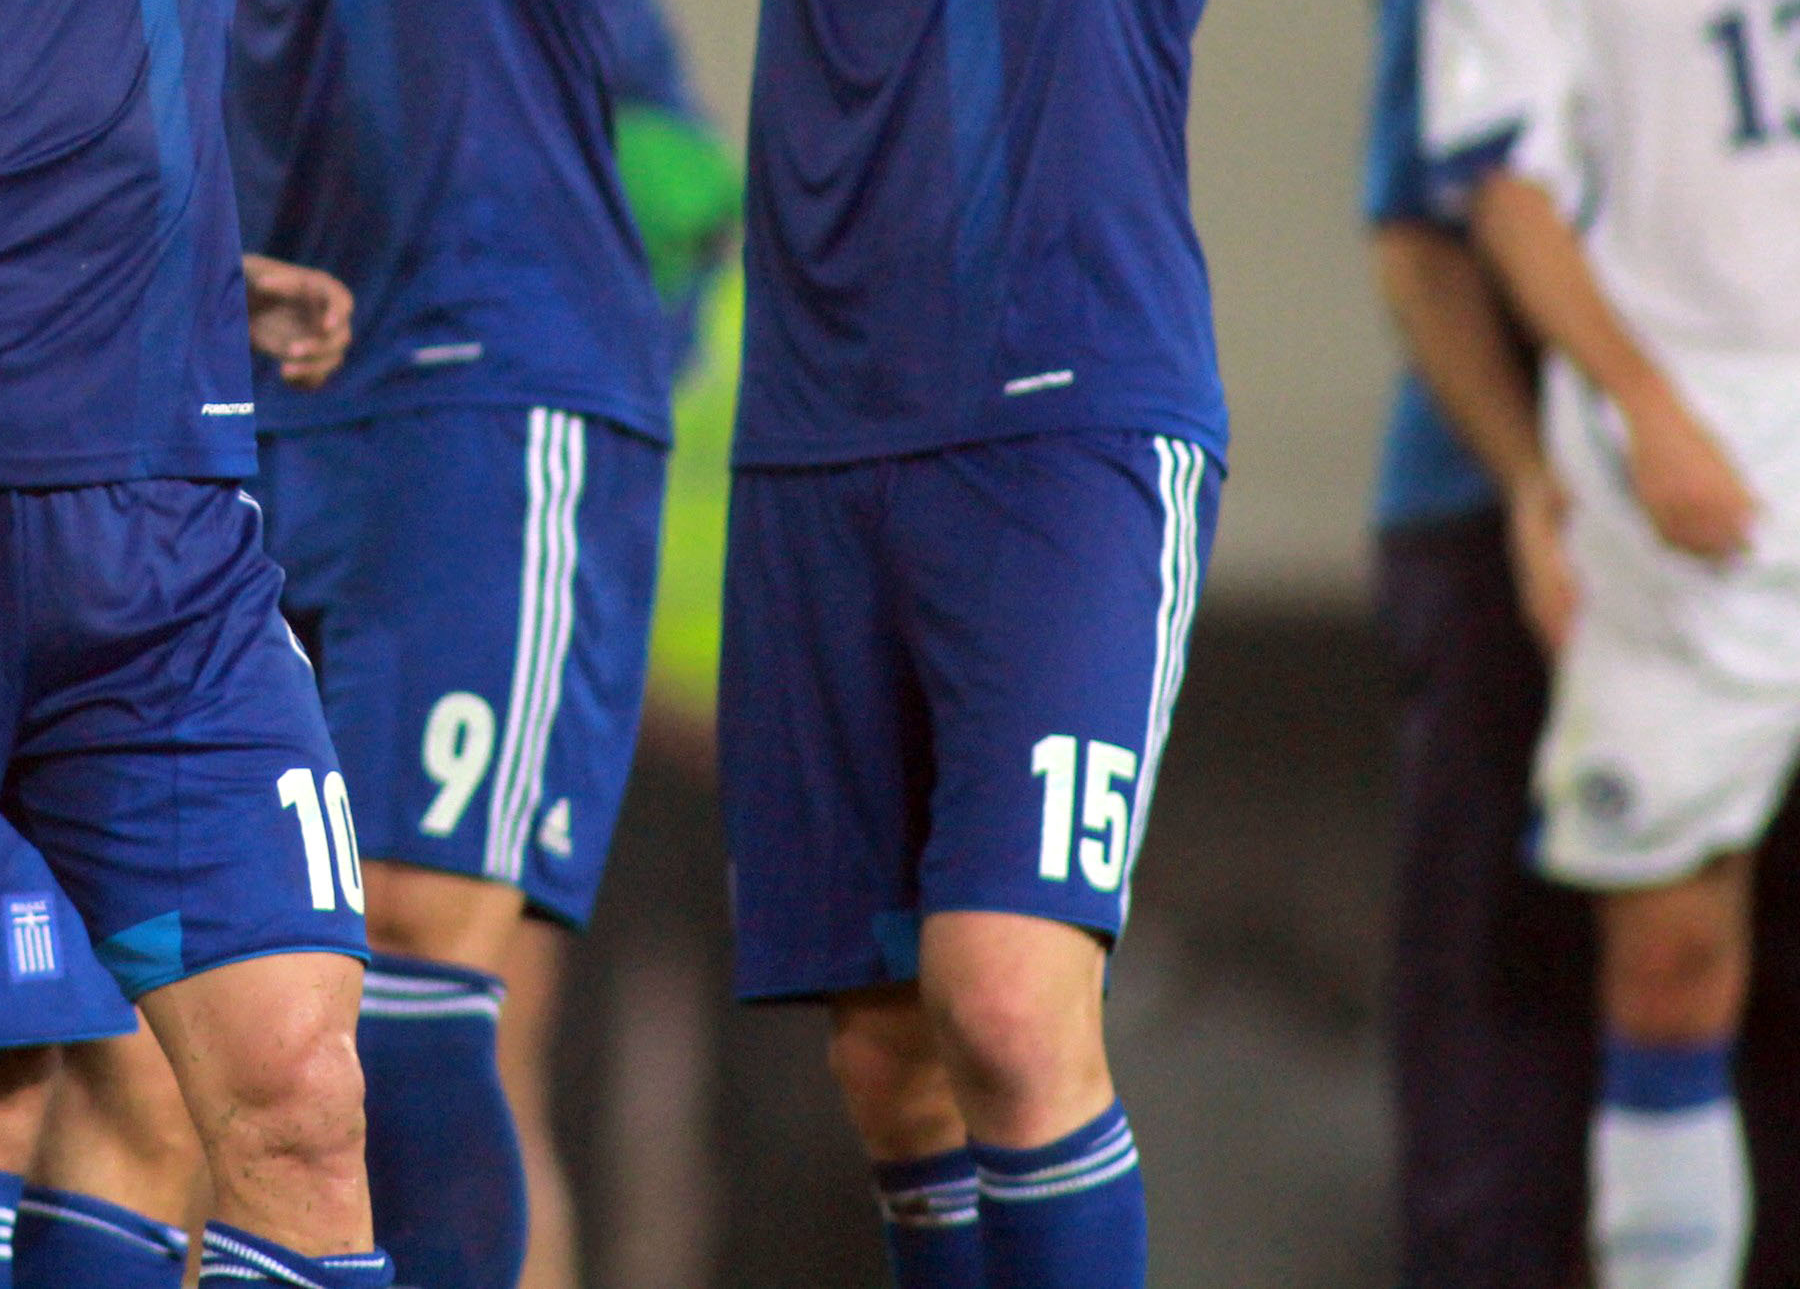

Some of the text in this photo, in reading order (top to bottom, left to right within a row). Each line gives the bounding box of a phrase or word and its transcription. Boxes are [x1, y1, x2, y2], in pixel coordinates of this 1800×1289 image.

[419, 690, 496, 838] 9
[1030, 733, 1137, 893] 15
[276, 767, 365, 916] 10
